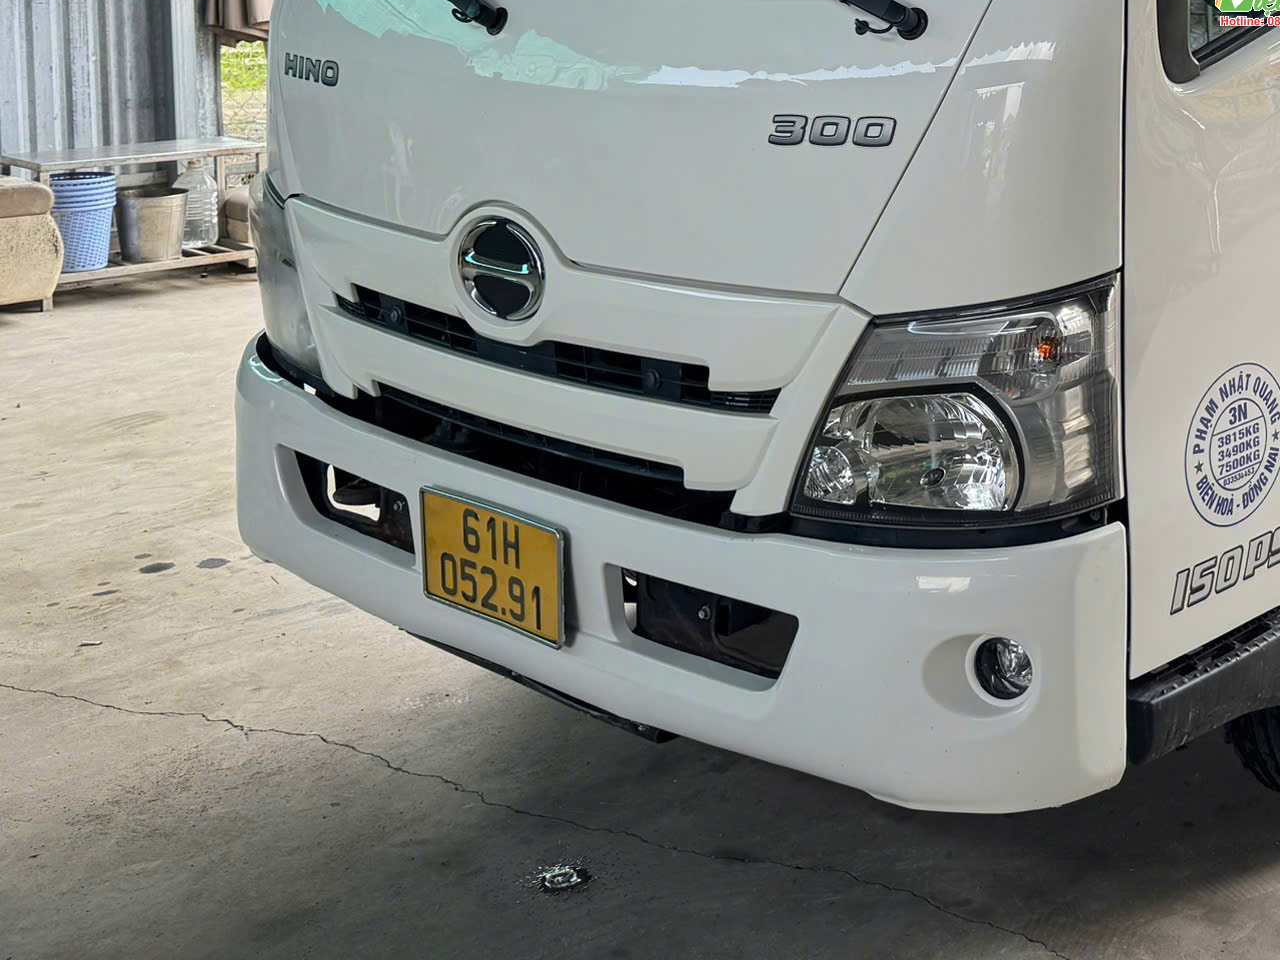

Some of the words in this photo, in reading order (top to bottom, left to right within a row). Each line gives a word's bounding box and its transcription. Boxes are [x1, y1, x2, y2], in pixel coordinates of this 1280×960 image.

[284, 52, 339, 88] HINO
[768, 113, 897, 148] 300
[1192, 397, 1219, 455] PHẠM
[1218, 370, 1251, 402] NHẬT
[1252, 376, 1280, 425] QUANG
[1228, 402, 1248, 426] 3N
[1217, 422, 1260, 449] 3815KG
[1217, 435, 1260, 462] 3490KG
[1195, 474, 1217, 511] BIÊN
[1242, 470, 1269, 510] ĐỒNG
[1264, 447, 1280, 474] NAI
[1218, 449, 1261, 476] 7500KG
[462, 507, 520, 570] 61H
[440, 551, 542, 631] 052.91
